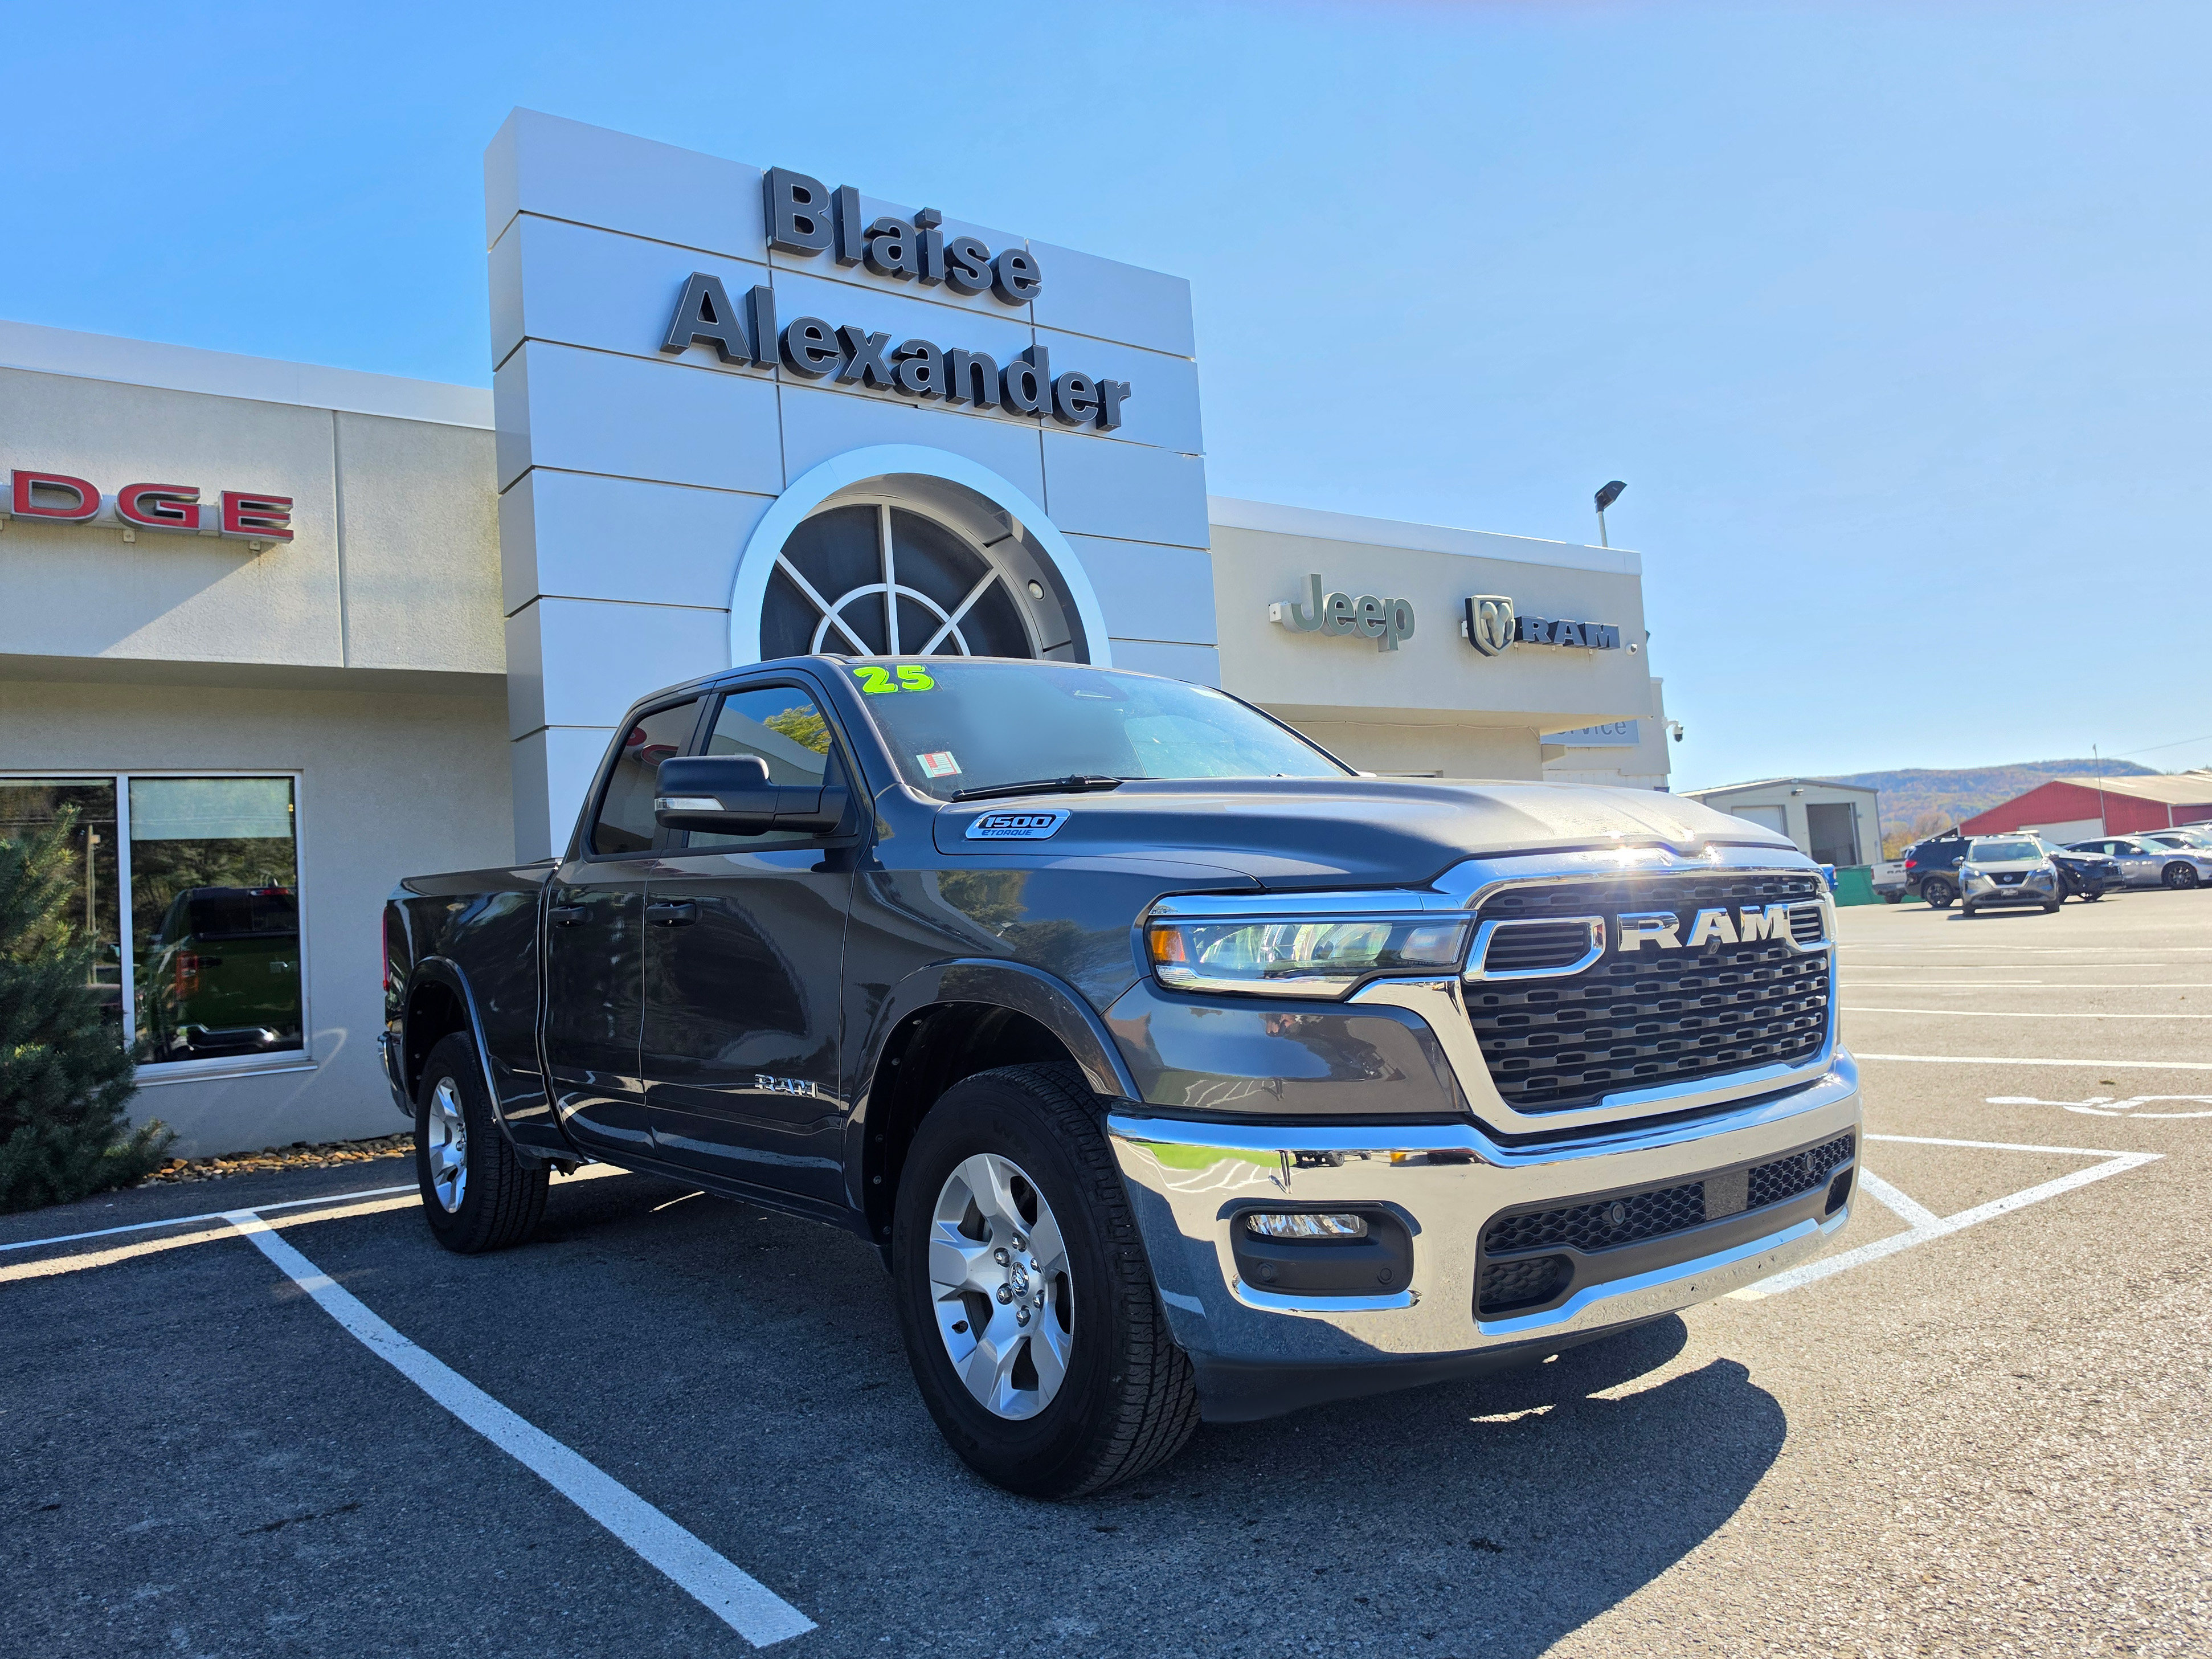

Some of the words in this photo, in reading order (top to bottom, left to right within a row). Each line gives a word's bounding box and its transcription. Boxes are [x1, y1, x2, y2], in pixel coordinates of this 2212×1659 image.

[763, 166, 1042, 307] Blaise
[660, 272, 1131, 432] Alexander
[1280, 573, 1416, 653] Jeep
[1514, 615, 1620, 650] RAM
[853, 664, 935, 694] 25
[985, 816, 1053, 828] 1500
[1617, 904, 1784, 951] RAM
[755, 1074, 817, 1098] RAM
